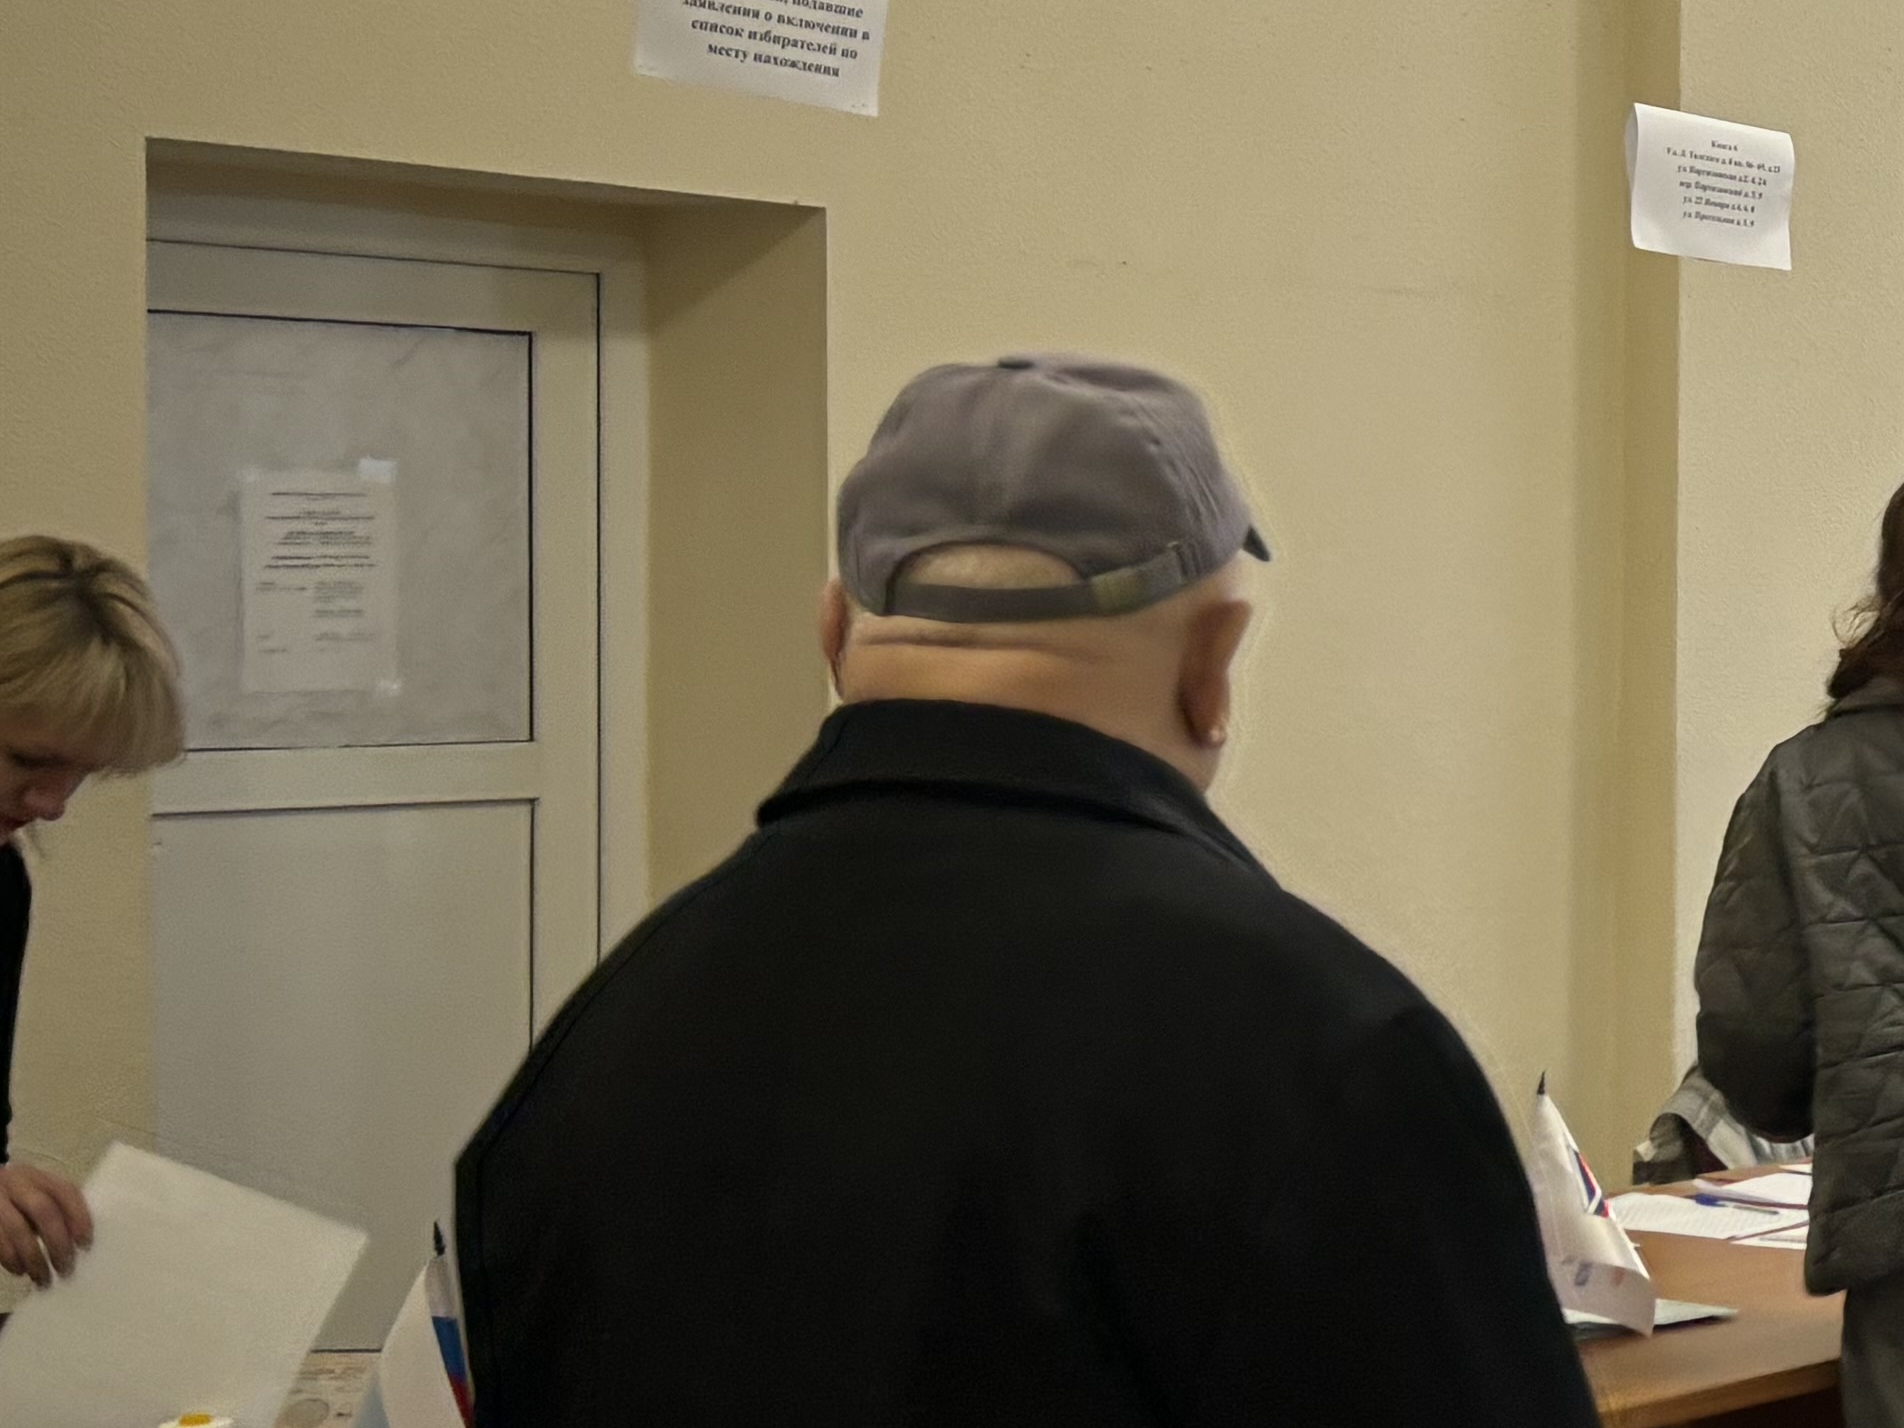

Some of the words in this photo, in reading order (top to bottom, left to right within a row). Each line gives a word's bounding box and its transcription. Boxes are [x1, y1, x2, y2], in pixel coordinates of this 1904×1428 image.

[691, 19, 744, 39] список
[748, 29, 837, 56] избирателей
[841, 47, 858, 60] по
[764, 11, 773, 22] о
[777, 14, 858, 39] включении
[862, 30, 870, 40] в
[707, 43, 748, 63] месту
[753, 50, 840, 78] нахождения
